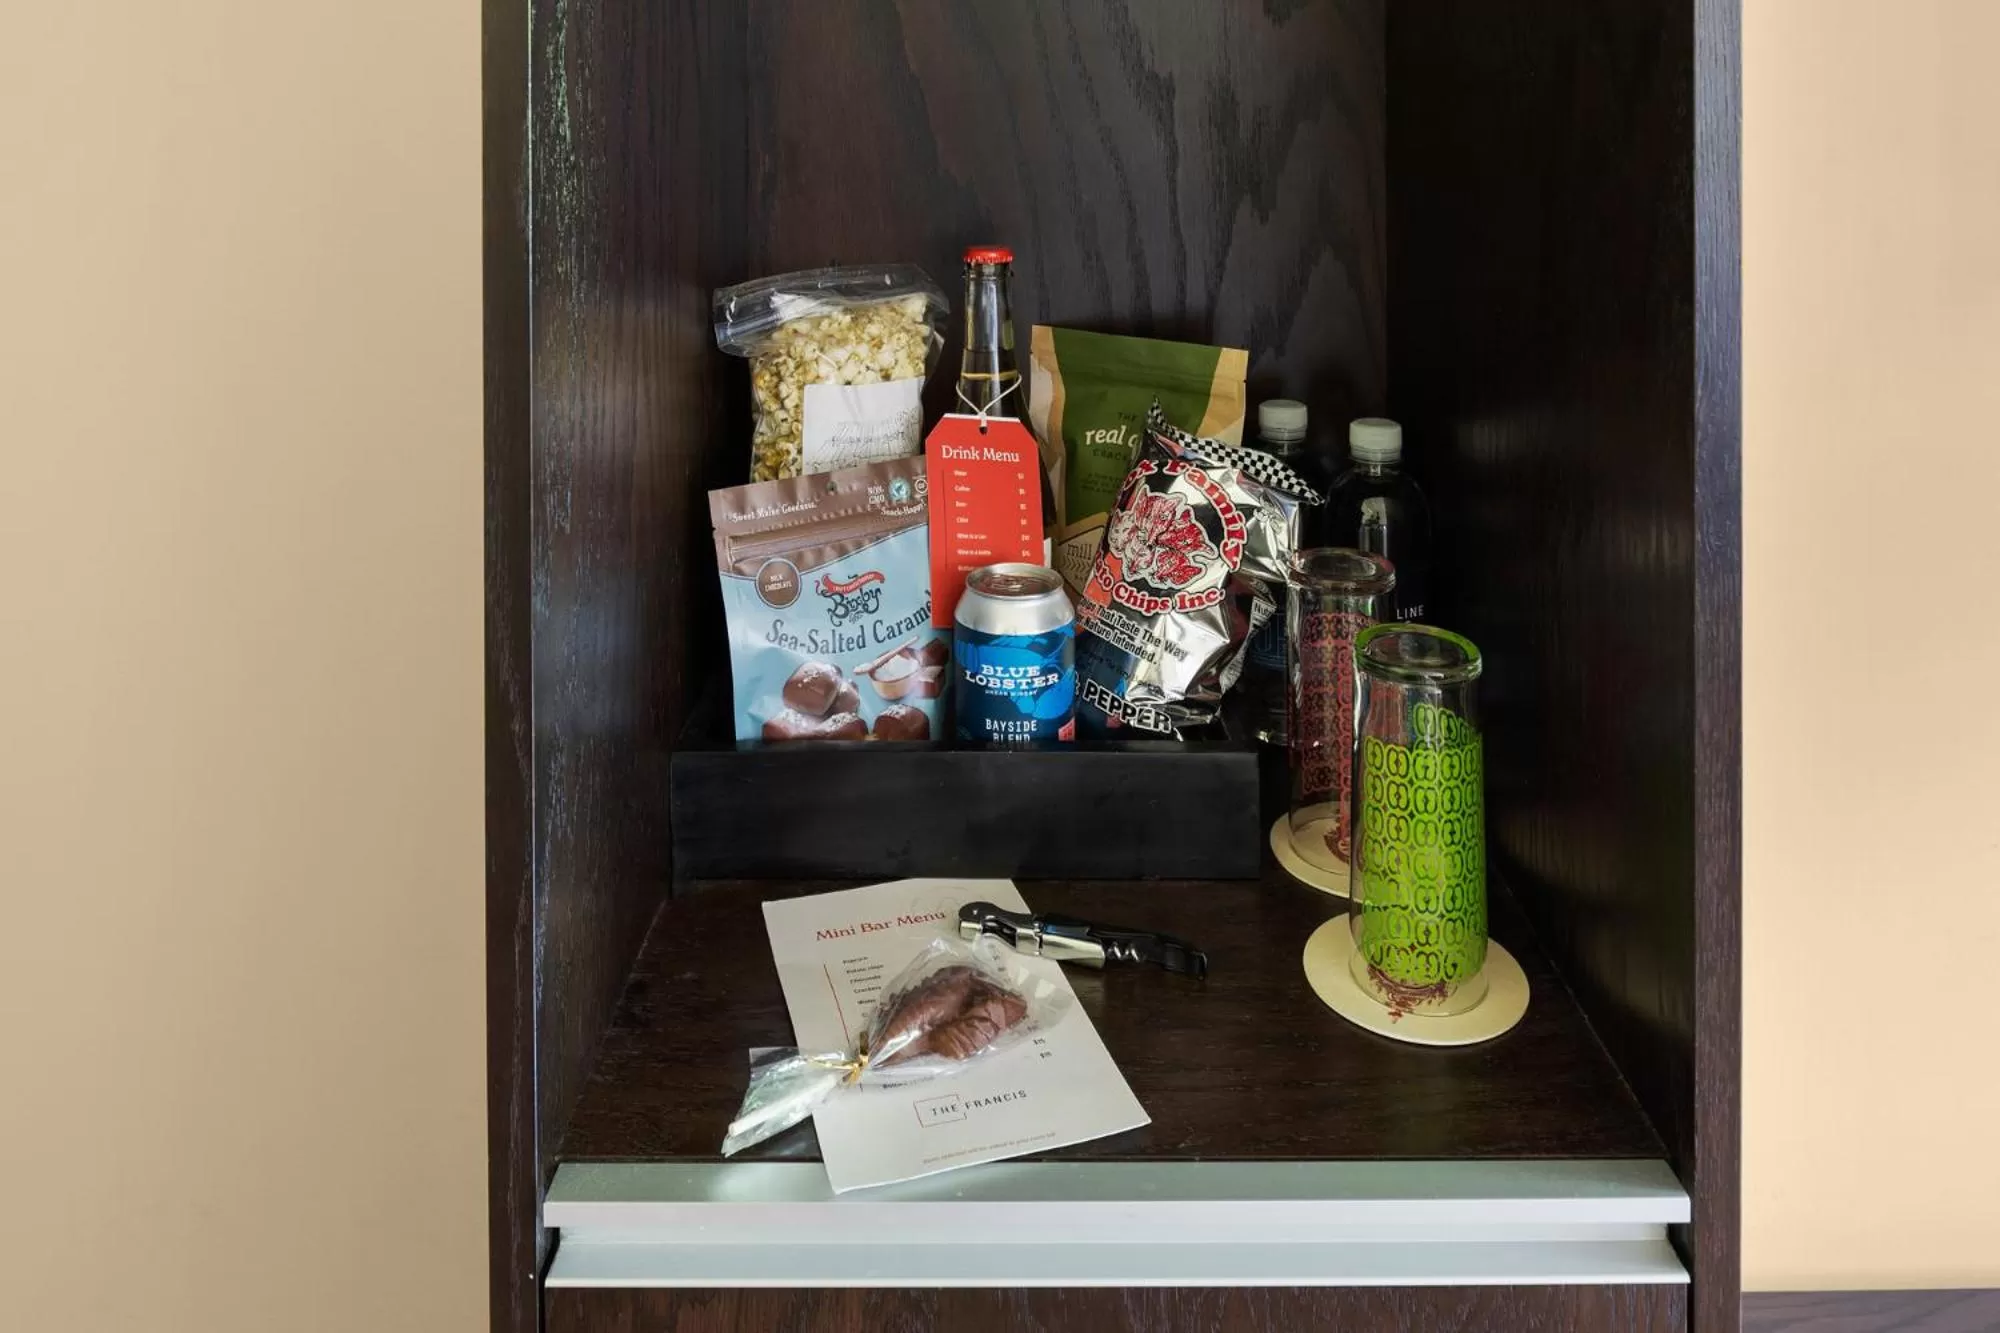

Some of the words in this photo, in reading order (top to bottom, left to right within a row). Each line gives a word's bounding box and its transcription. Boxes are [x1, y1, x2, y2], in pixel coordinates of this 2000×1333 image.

[1085, 424, 1127, 446] real
[941, 444, 981, 461] Drink
[982, 447, 1021, 463] Menu
[1112, 580, 1173, 617] Chips
[765, 618, 867, 656] Sea-Salted
[872, 590, 933, 645] Carame
[1396, 604, 1425, 620] LINE
[1112, 631, 1158, 665] Intended.
[1116, 614, 1141, 637] Taste
[1141, 628, 1162, 648] The
[1163, 639, 1192, 663] Way
[964, 670, 1059, 689] LOBSTER
[981, 664, 1041, 678] BLUE
[1082, 678, 1172, 734] PEPPER
[985, 718, 1038, 733] BAYSIDE
[992, 732, 1031, 743] BLEND
[816, 924, 857, 941] Mini
[860, 920, 893, 934] Bar
[897, 911, 947, 927] Menu
[931, 1102, 960, 1117] THE
[965, 1089, 1028, 1110] FRANCIS
